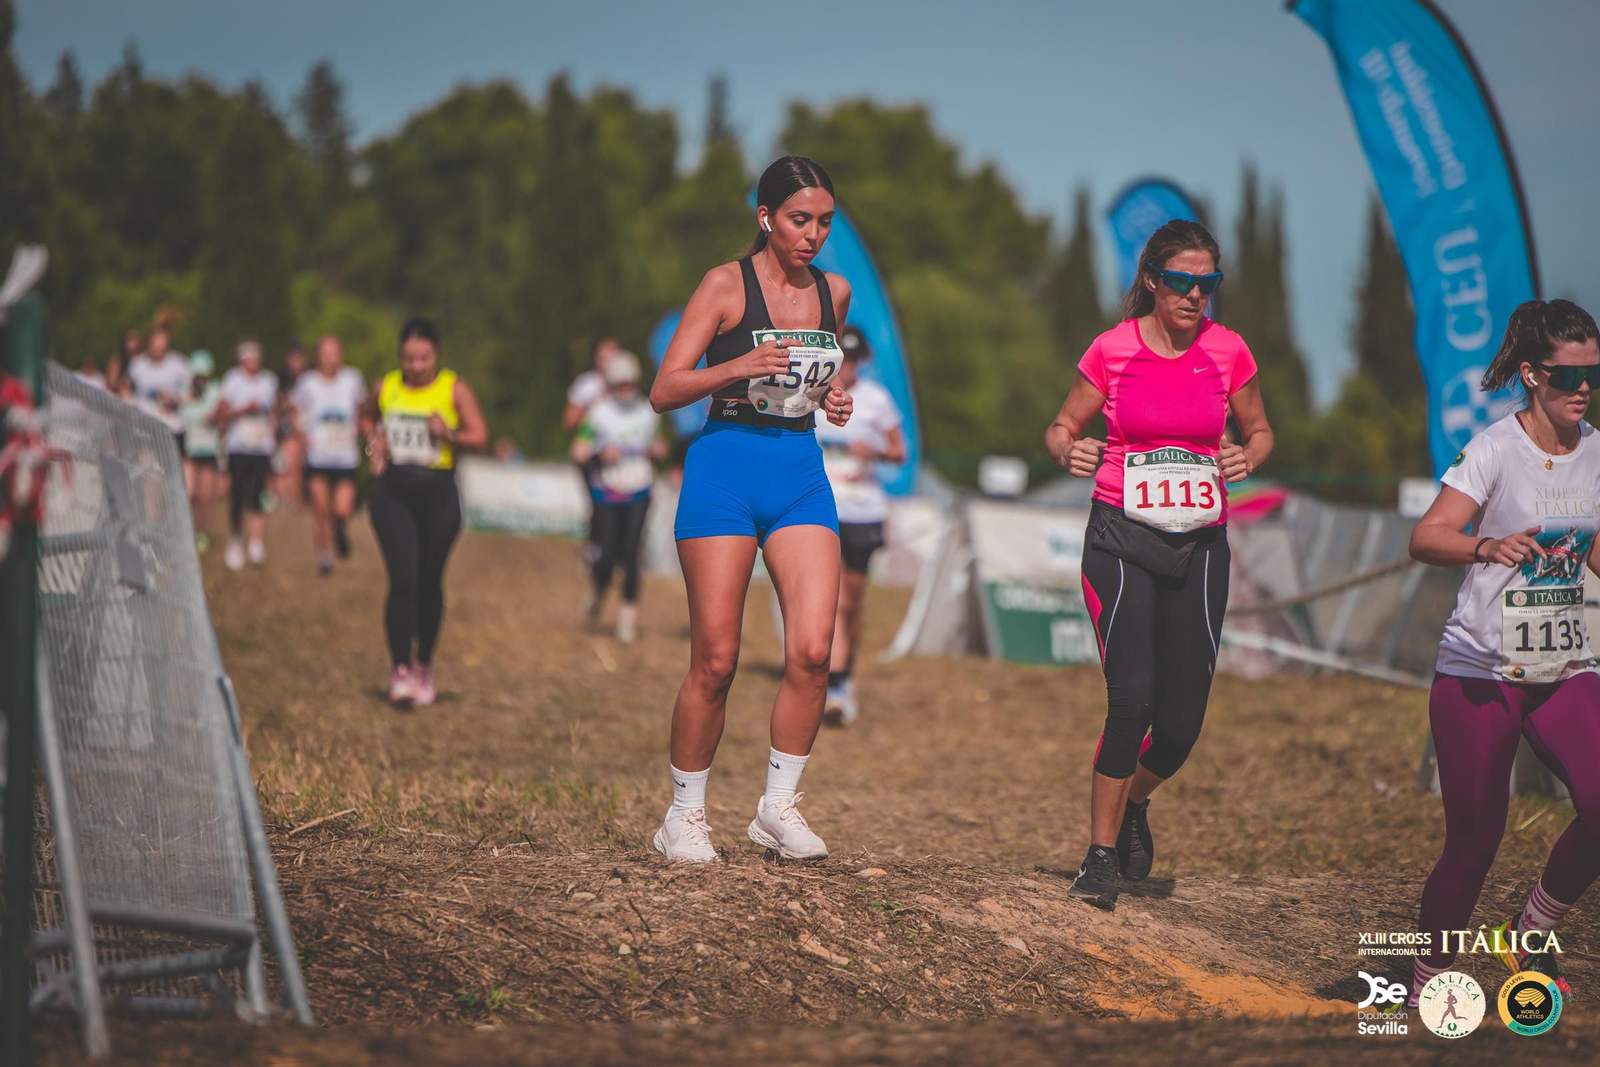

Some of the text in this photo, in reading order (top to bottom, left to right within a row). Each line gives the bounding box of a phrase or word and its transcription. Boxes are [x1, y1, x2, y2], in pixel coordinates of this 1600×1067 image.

[1152, 448, 1195, 462] ITÁLICA
[1135, 480, 1215, 509] 1113
[1534, 589, 1572, 603] ITÁLICA
[1515, 619, 1583, 651] 1135
